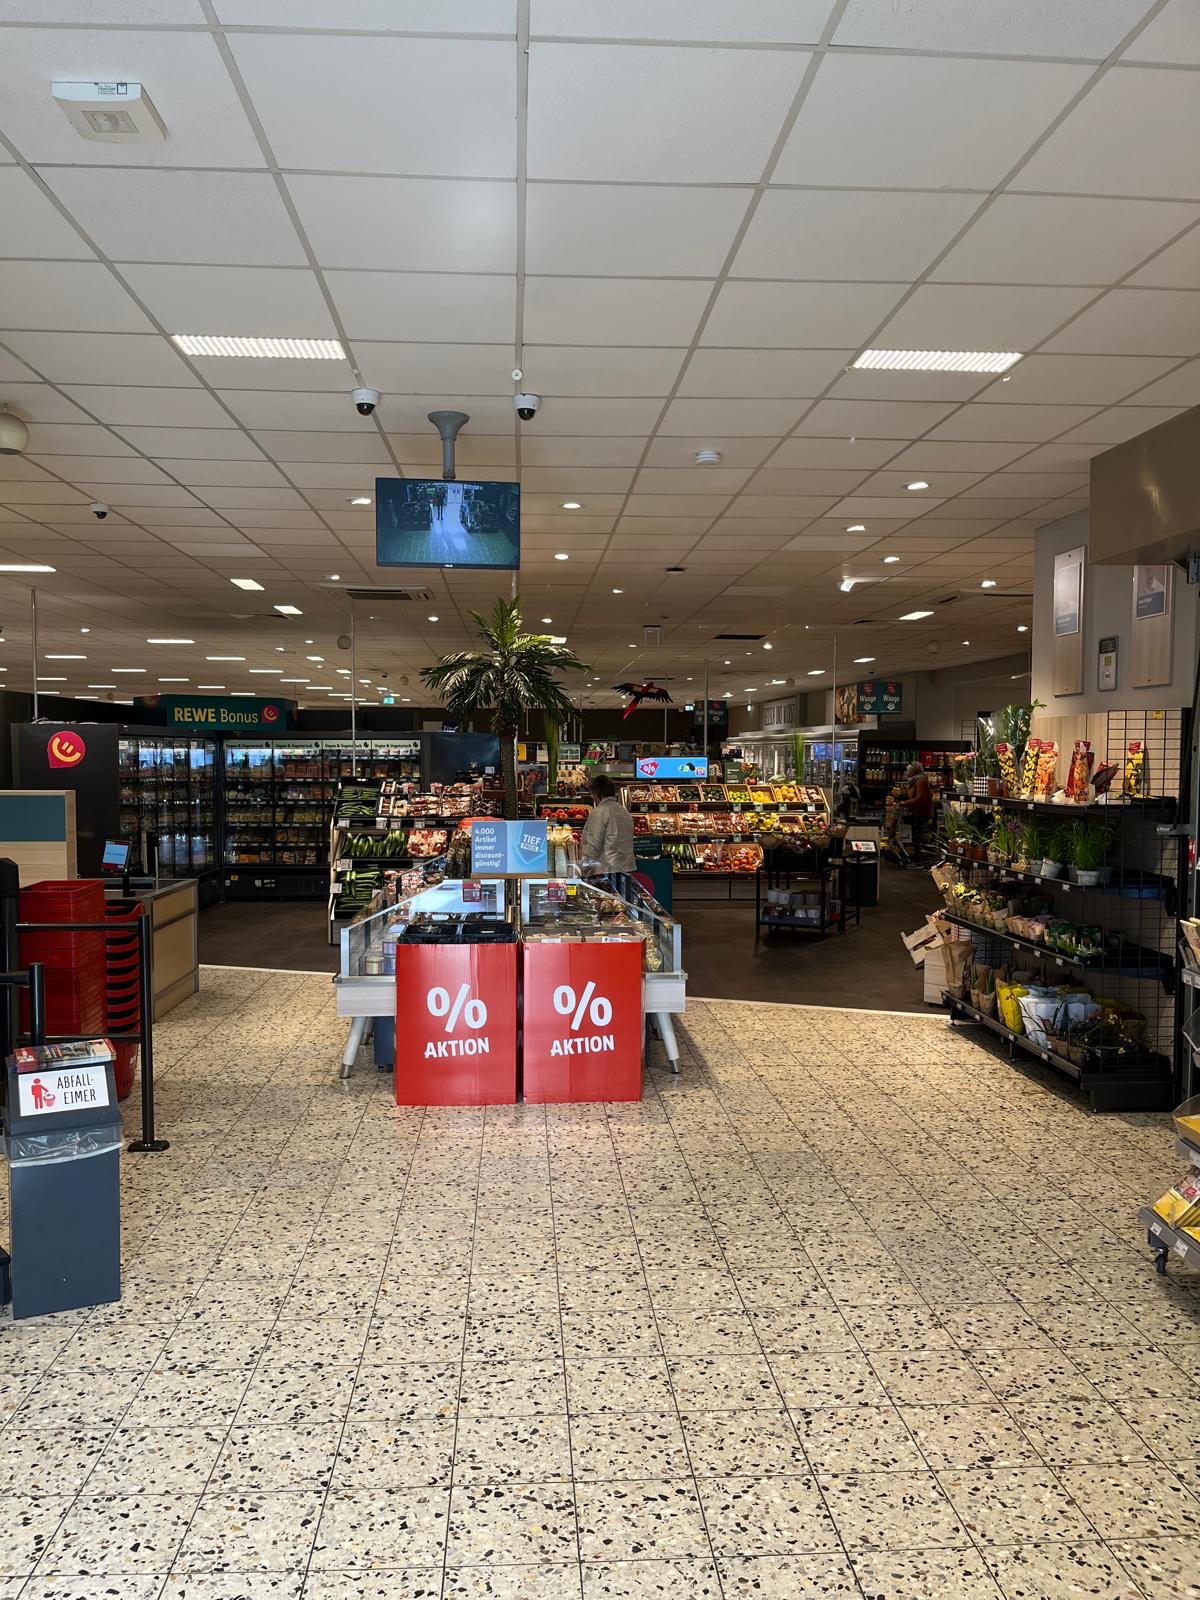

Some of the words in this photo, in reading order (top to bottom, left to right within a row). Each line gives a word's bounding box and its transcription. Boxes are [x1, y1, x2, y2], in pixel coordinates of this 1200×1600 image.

[174, 707, 217, 722] REWE
[220, 708, 258, 723] Bonus
[523, 834, 541, 846] TIEF
[475, 860, 501, 868] günstig!
[427, 983, 488, 1033] %
[553, 981, 613, 1031] %
[424, 1037, 490, 1059] AKTION
[550, 1034, 615, 1056] AKTION
[57, 1073, 94, 1089] ABFALL-
[64, 1089, 96, 1105] EIMER
